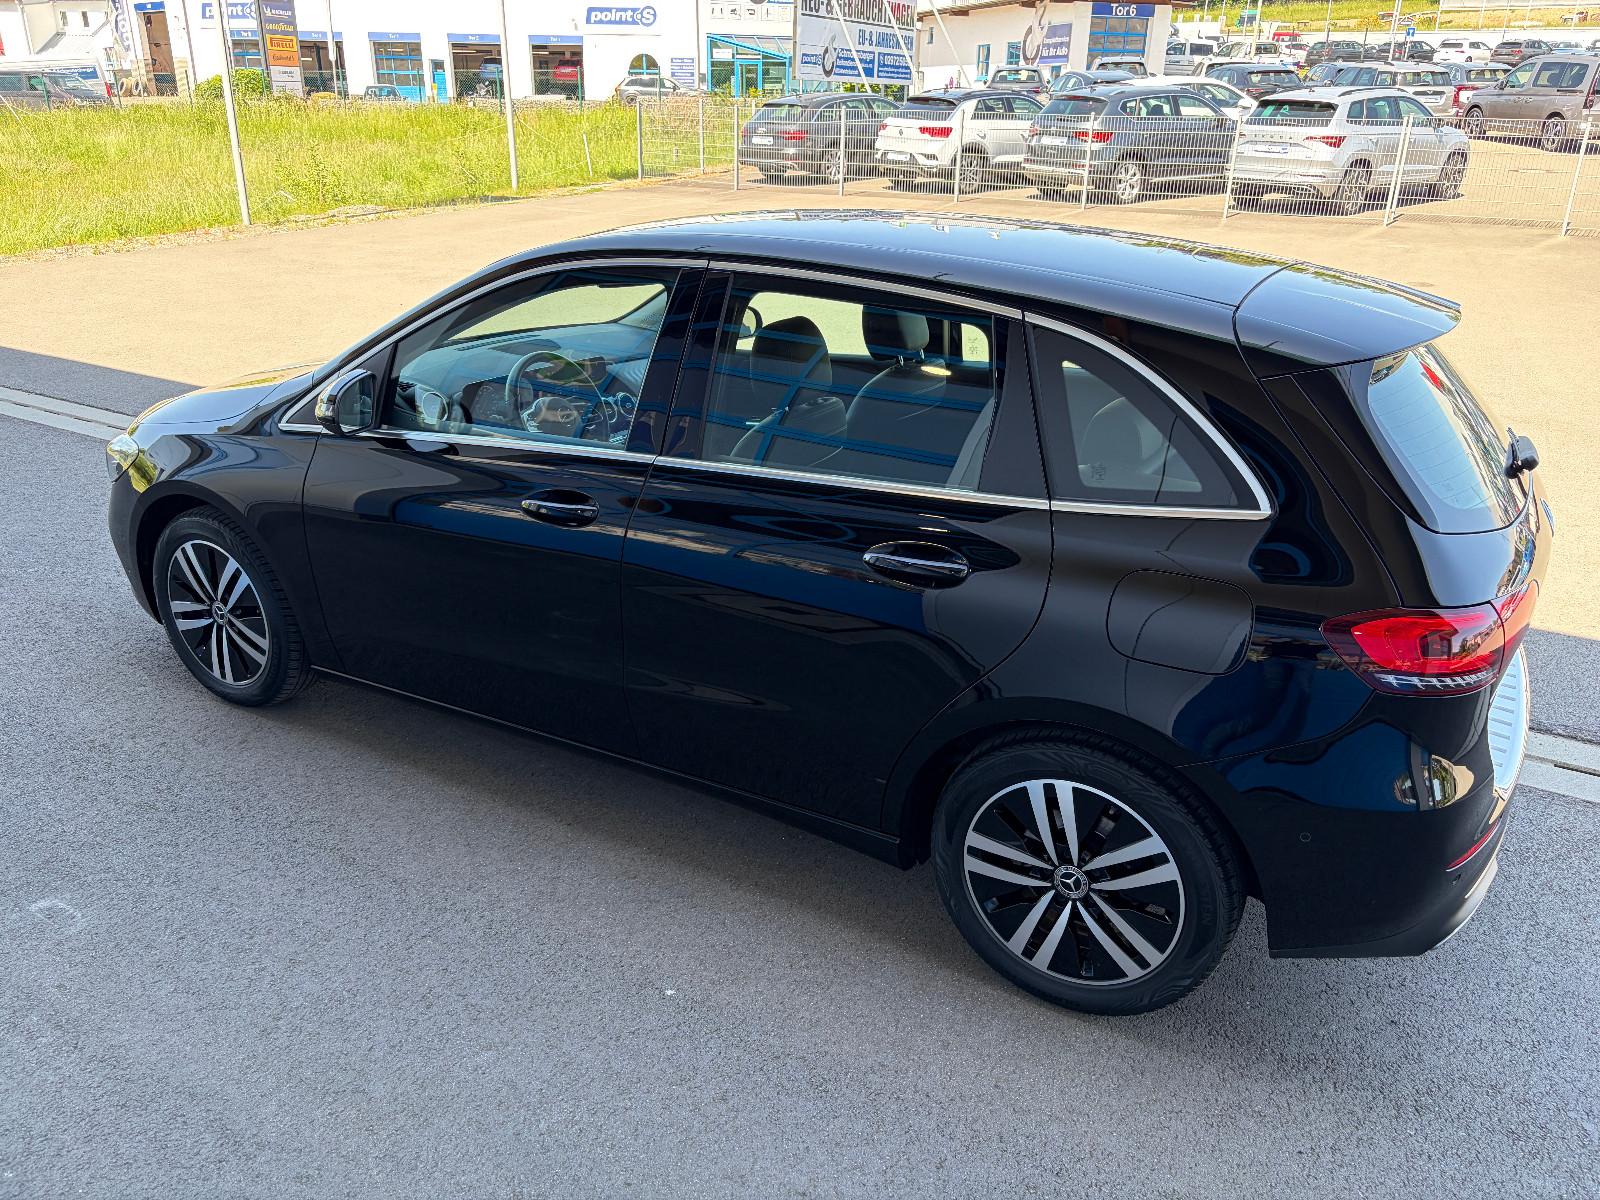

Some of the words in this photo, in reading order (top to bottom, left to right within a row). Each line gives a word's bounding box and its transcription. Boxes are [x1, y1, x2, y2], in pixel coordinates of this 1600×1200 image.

[205, 4, 243, 18] pnt
[590, 9, 633, 24] point
[270, 37, 294, 49] PIRELLI
